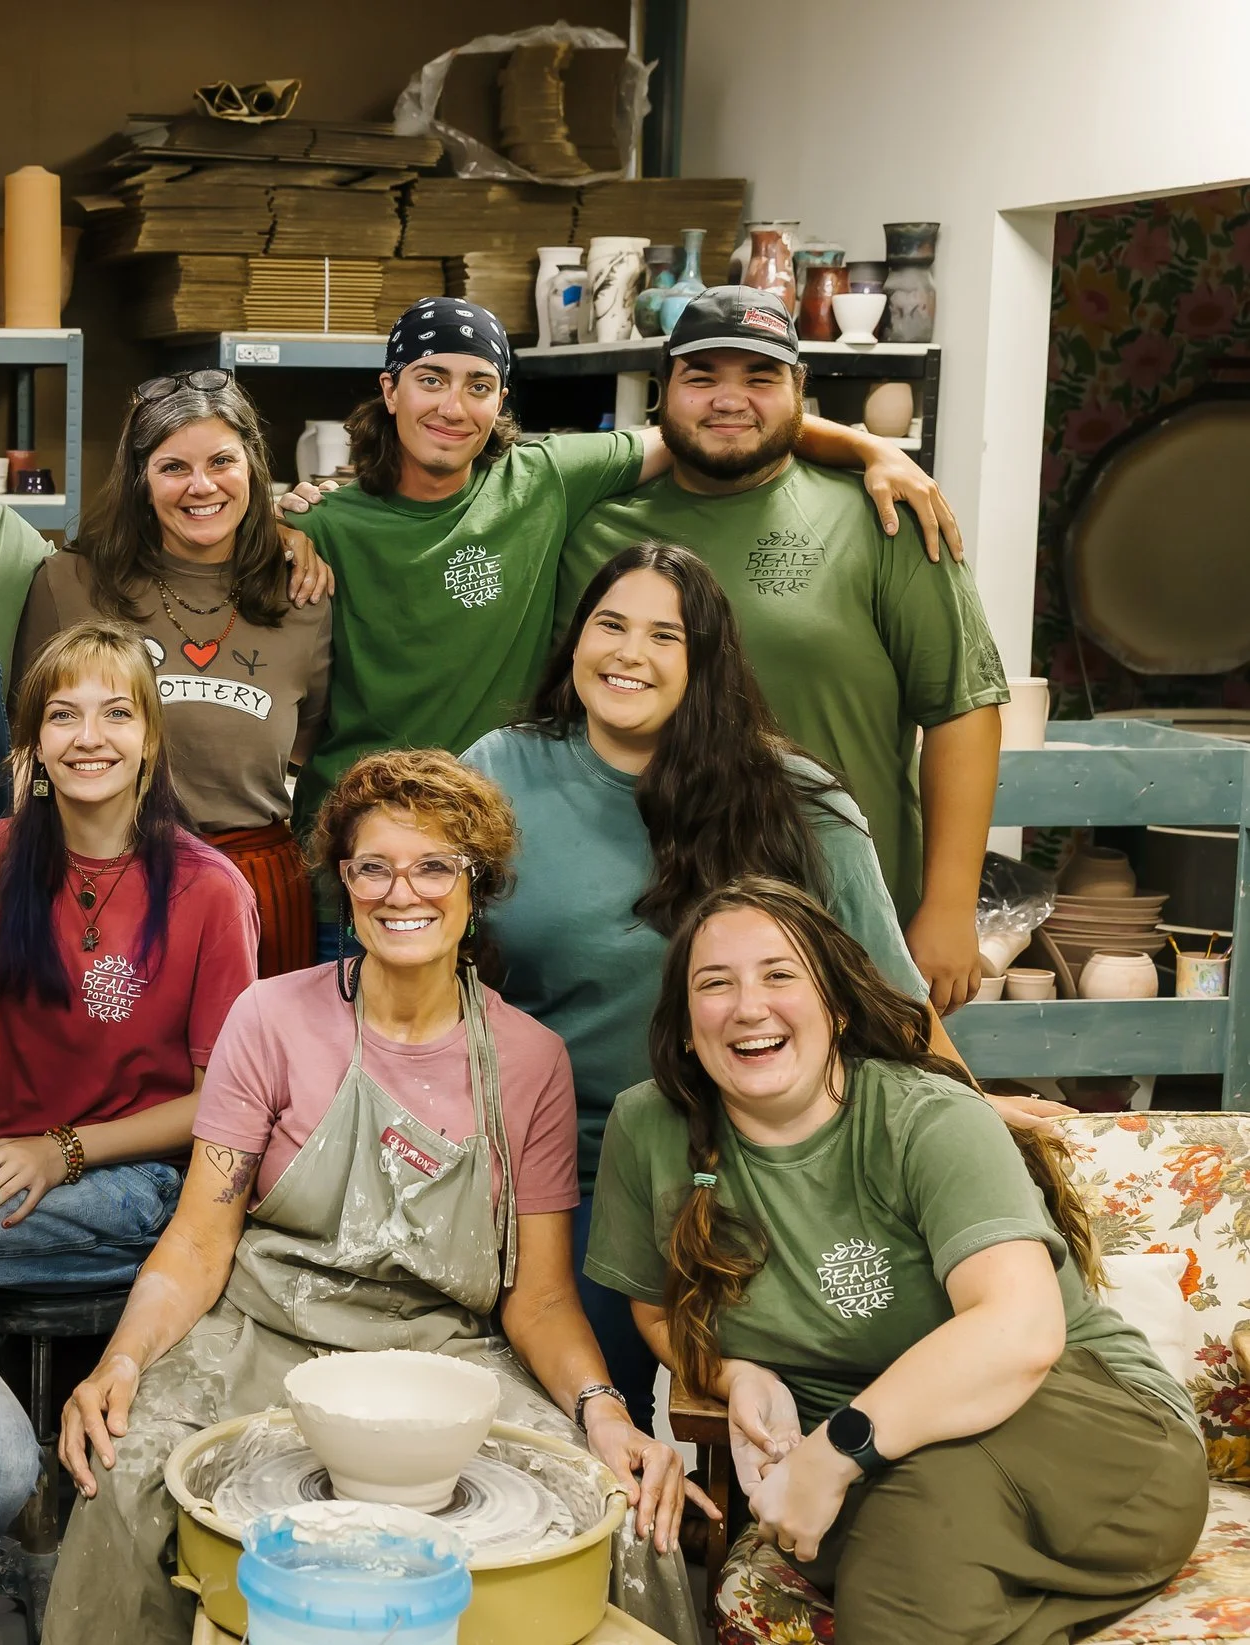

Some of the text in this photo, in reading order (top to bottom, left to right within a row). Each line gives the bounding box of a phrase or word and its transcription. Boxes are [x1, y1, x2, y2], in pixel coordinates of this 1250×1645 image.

[745, 552, 819, 571] BEALE
[754, 569, 812, 577] POTTERY
[443, 560, 502, 590] BEALE
[454, 575, 499, 594] POTTERY
[158, 679, 267, 711] OTTERY
[81, 970, 142, 998] BEALE
[86, 989, 135, 1008] POTTERY
[816, 1256, 893, 1292] BEALE
[829, 1275, 890, 1298] POTTERY
